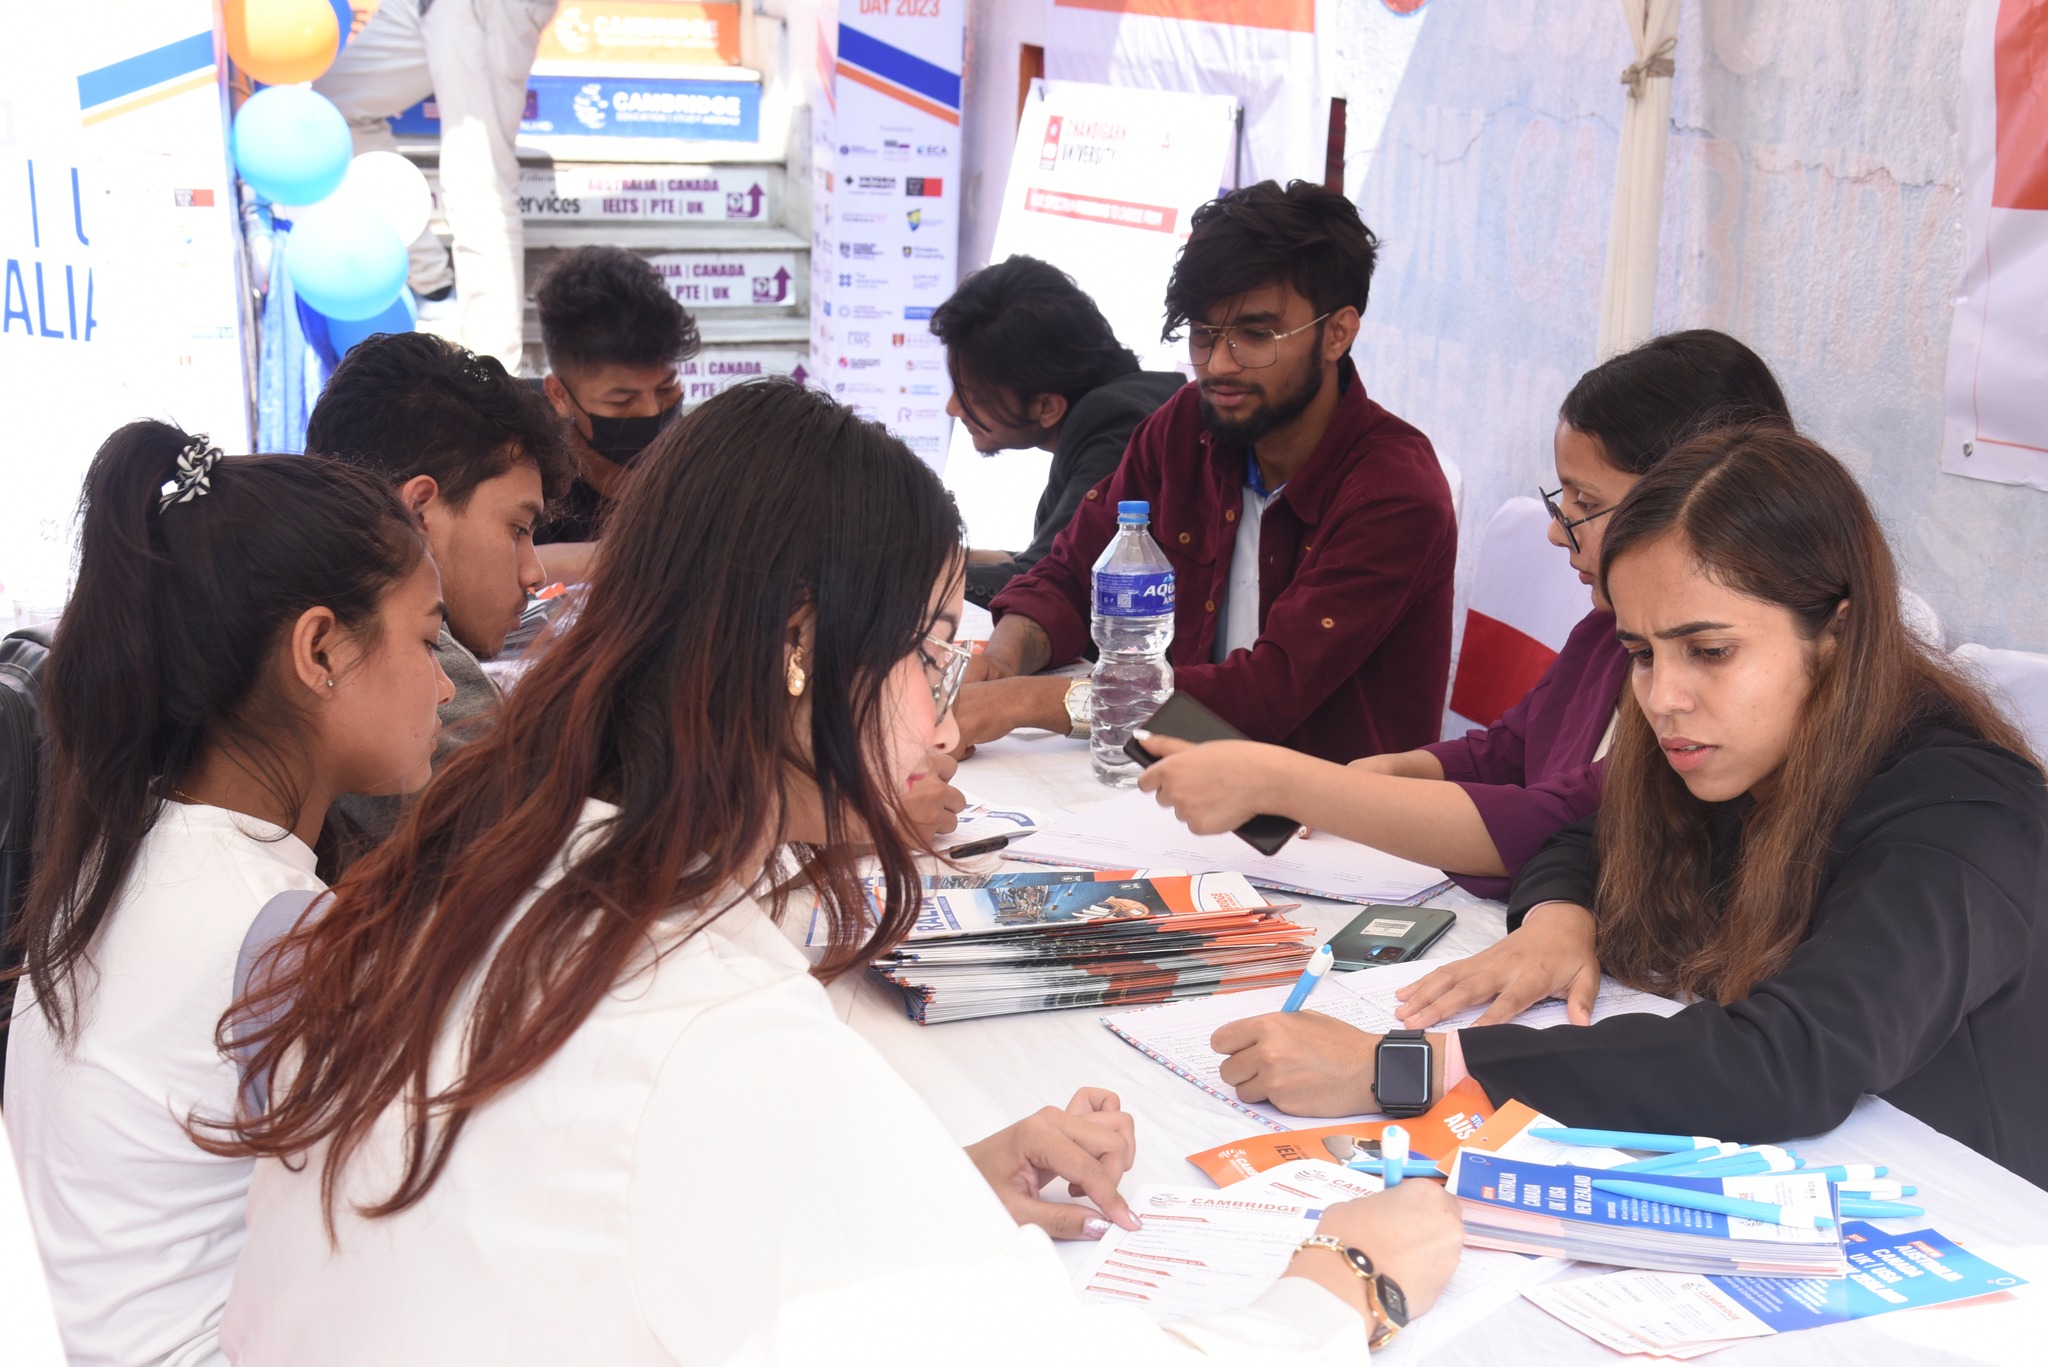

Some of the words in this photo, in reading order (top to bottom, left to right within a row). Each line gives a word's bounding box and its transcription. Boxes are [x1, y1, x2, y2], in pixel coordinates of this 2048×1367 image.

[860, 0, 890, 14] DAY
[896, 0, 940, 17] 2023
[613, 91, 741, 116] CAMBRIDGE
[668, 180, 719, 191] CANADA
[519, 190, 580, 214] ervices
[603, 199, 638, 214] IELTS
[651, 200, 675, 214] PTE
[687, 201, 704, 214] UK
[693, 264, 745, 277] CANADA
[676, 286, 700, 300] PTE
[713, 287, 730, 299] UK
[709, 362, 762, 375] CANADA
[691, 383, 715, 397] PTE
[1143, 583, 1175, 597] AQU
[1443, 1112, 1476, 1140] AUS
[1470, 1114, 1484, 1128] STU
[1274, 1145, 1302, 1160] IELT
[1498, 1173, 1516, 1203] AUSTRALIA
[1523, 1184, 1541, 1207] CANADA
[1549, 1187, 1566, 1199] USA
[1574, 1175, 1592, 1201] ZEALAND
[1191, 1198, 1302, 1213] CAMBRIDGE
[1549, 1201, 1566, 1211] UK
[1574, 1200, 1592, 1215] NEW
[1849, 1253, 1876, 1265] UK
[1870, 1267, 1903, 1284] USA
[1872, 1248, 1925, 1278] CANADA
[1893, 1245, 1964, 1282] AUSTRALIA
[1849, 1273, 1909, 1304] ZEALAND
[1699, 1290, 1741, 1321] CAMBRIDGE
